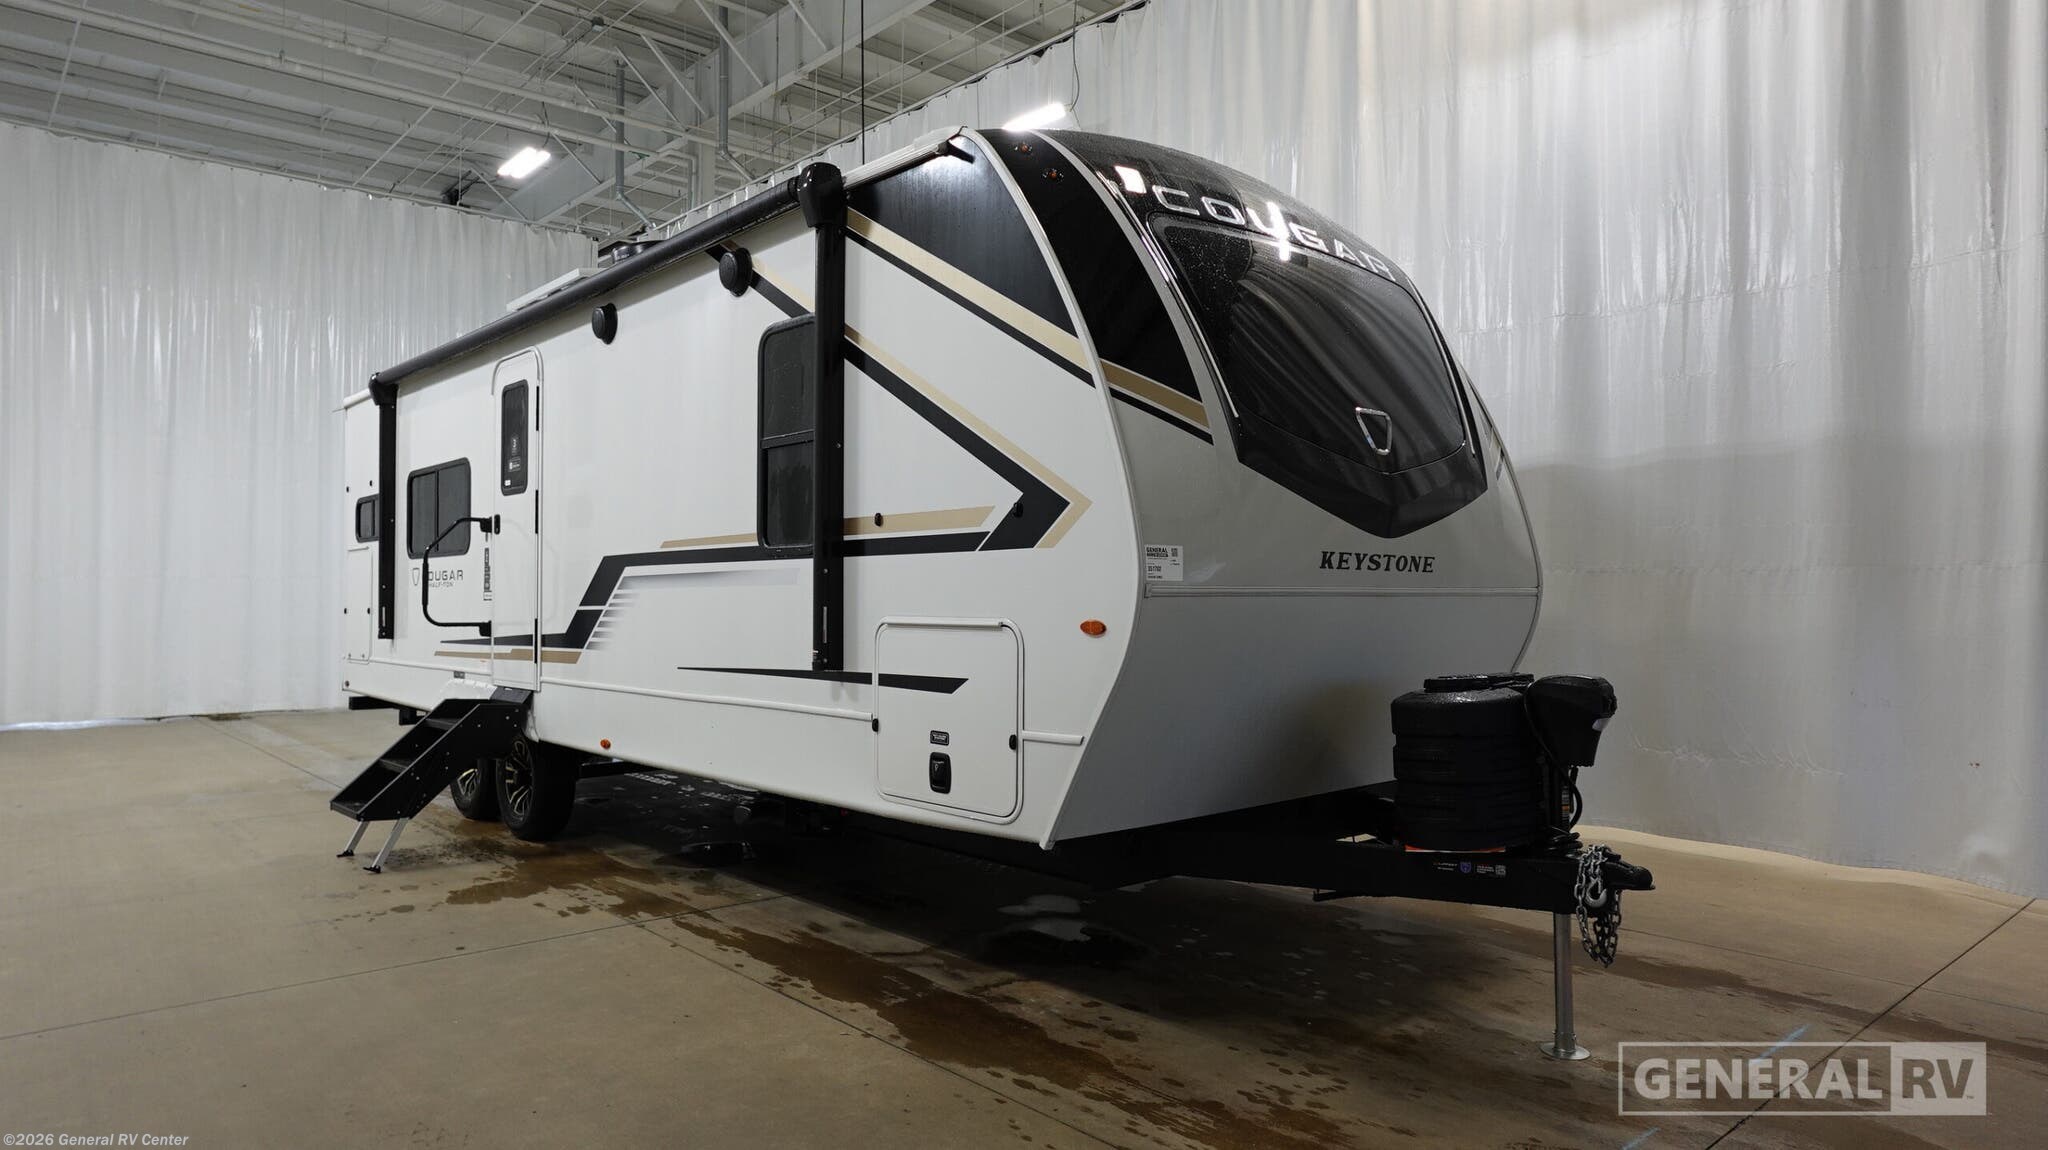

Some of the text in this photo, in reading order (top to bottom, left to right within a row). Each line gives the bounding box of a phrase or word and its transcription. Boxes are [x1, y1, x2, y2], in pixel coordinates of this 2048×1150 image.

[1152, 185, 1396, 282] COUGAR
[1320, 551, 1435, 573] KEYSTONE
[427, 570, 463, 581] OUGAR
